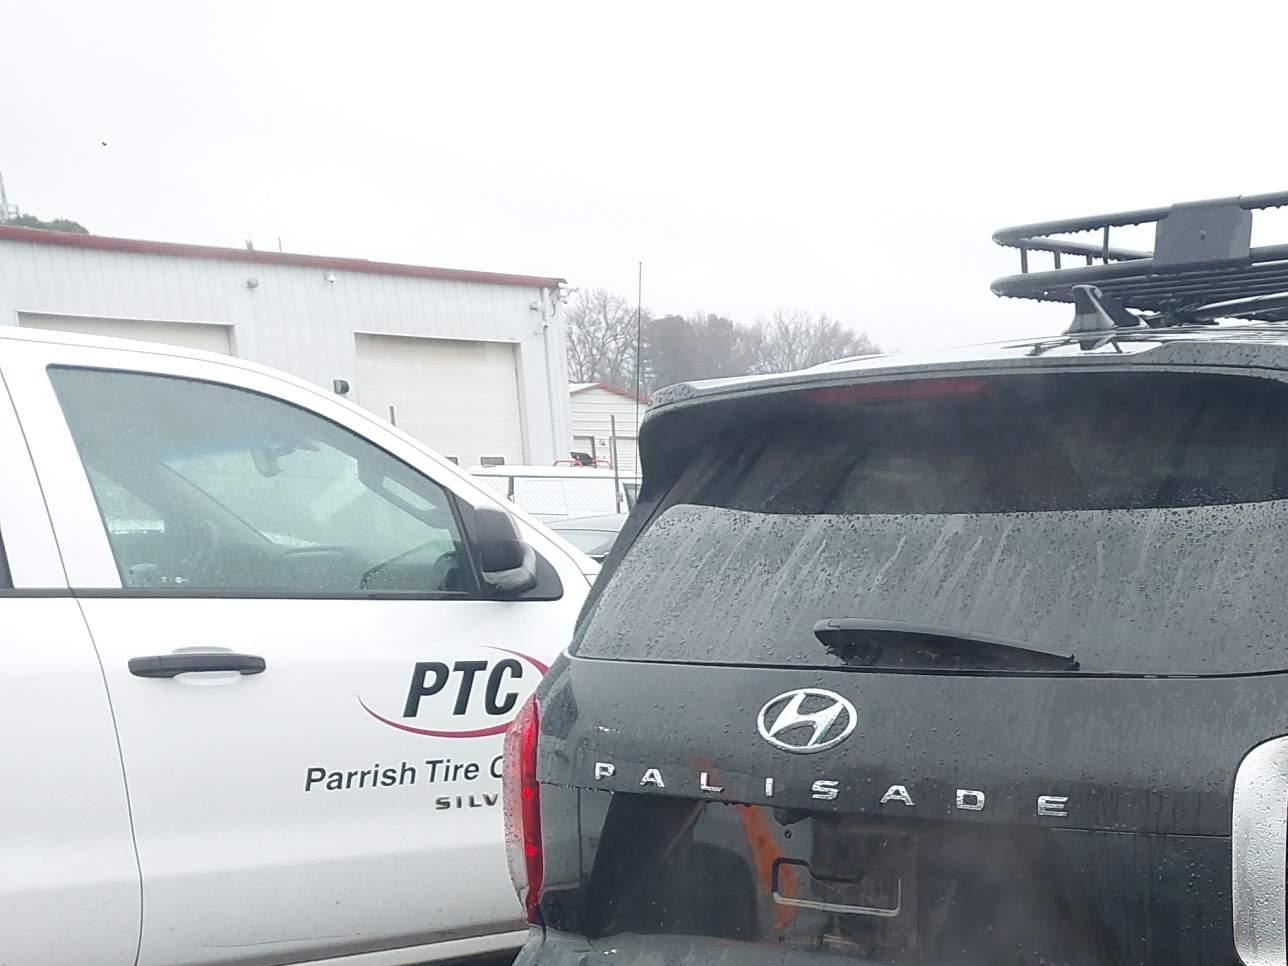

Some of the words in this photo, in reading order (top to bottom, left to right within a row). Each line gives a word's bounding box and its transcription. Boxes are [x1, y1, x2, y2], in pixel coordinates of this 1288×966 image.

[402, 657, 523, 718] PTC
[304, 759, 416, 792] Parrish
[424, 758, 480, 782] Tire
[594, 762, 1069, 817] PALISADE
